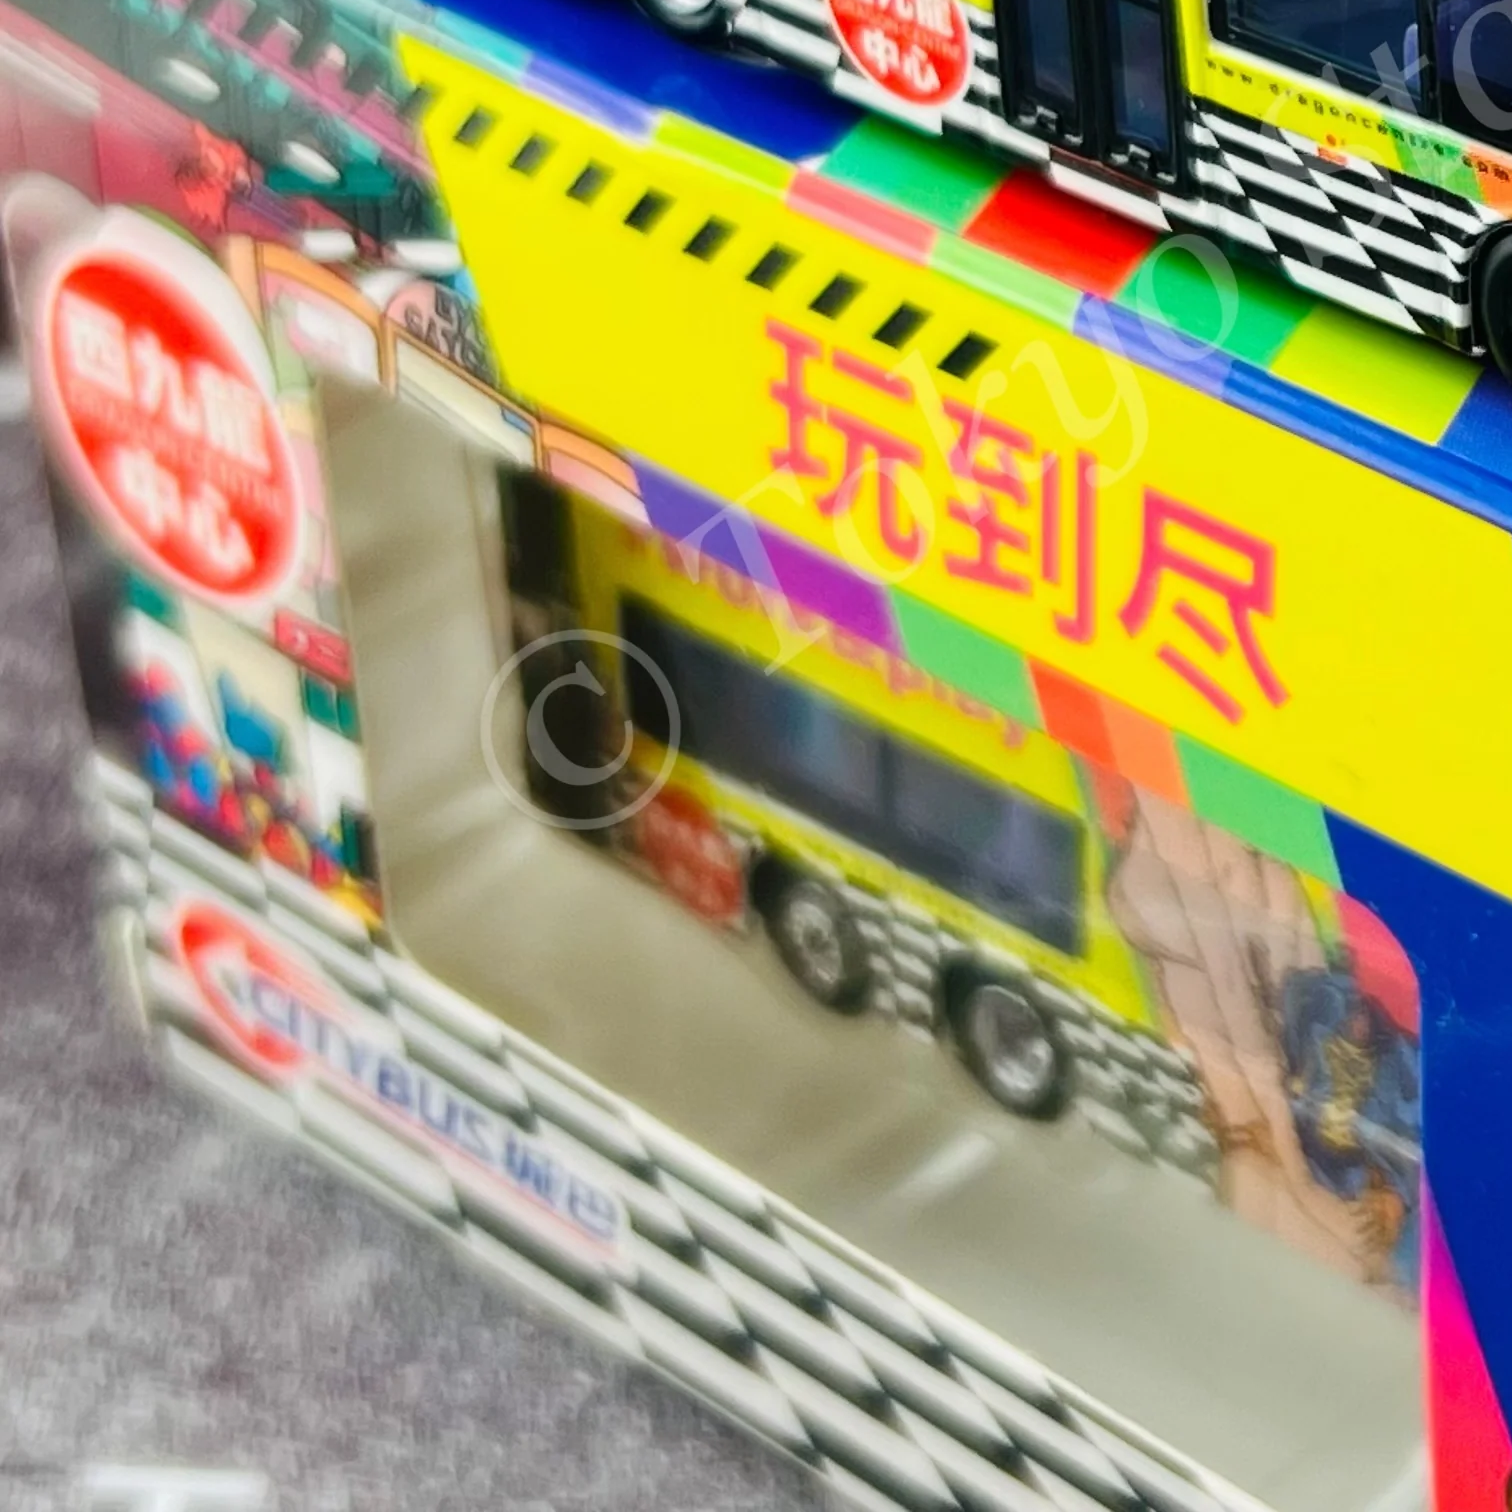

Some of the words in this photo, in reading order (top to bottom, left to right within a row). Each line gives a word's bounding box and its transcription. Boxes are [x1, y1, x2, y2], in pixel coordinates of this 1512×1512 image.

[861, 28, 942, 94] 中心
[765, 317, 1292, 726] 玩到尽
